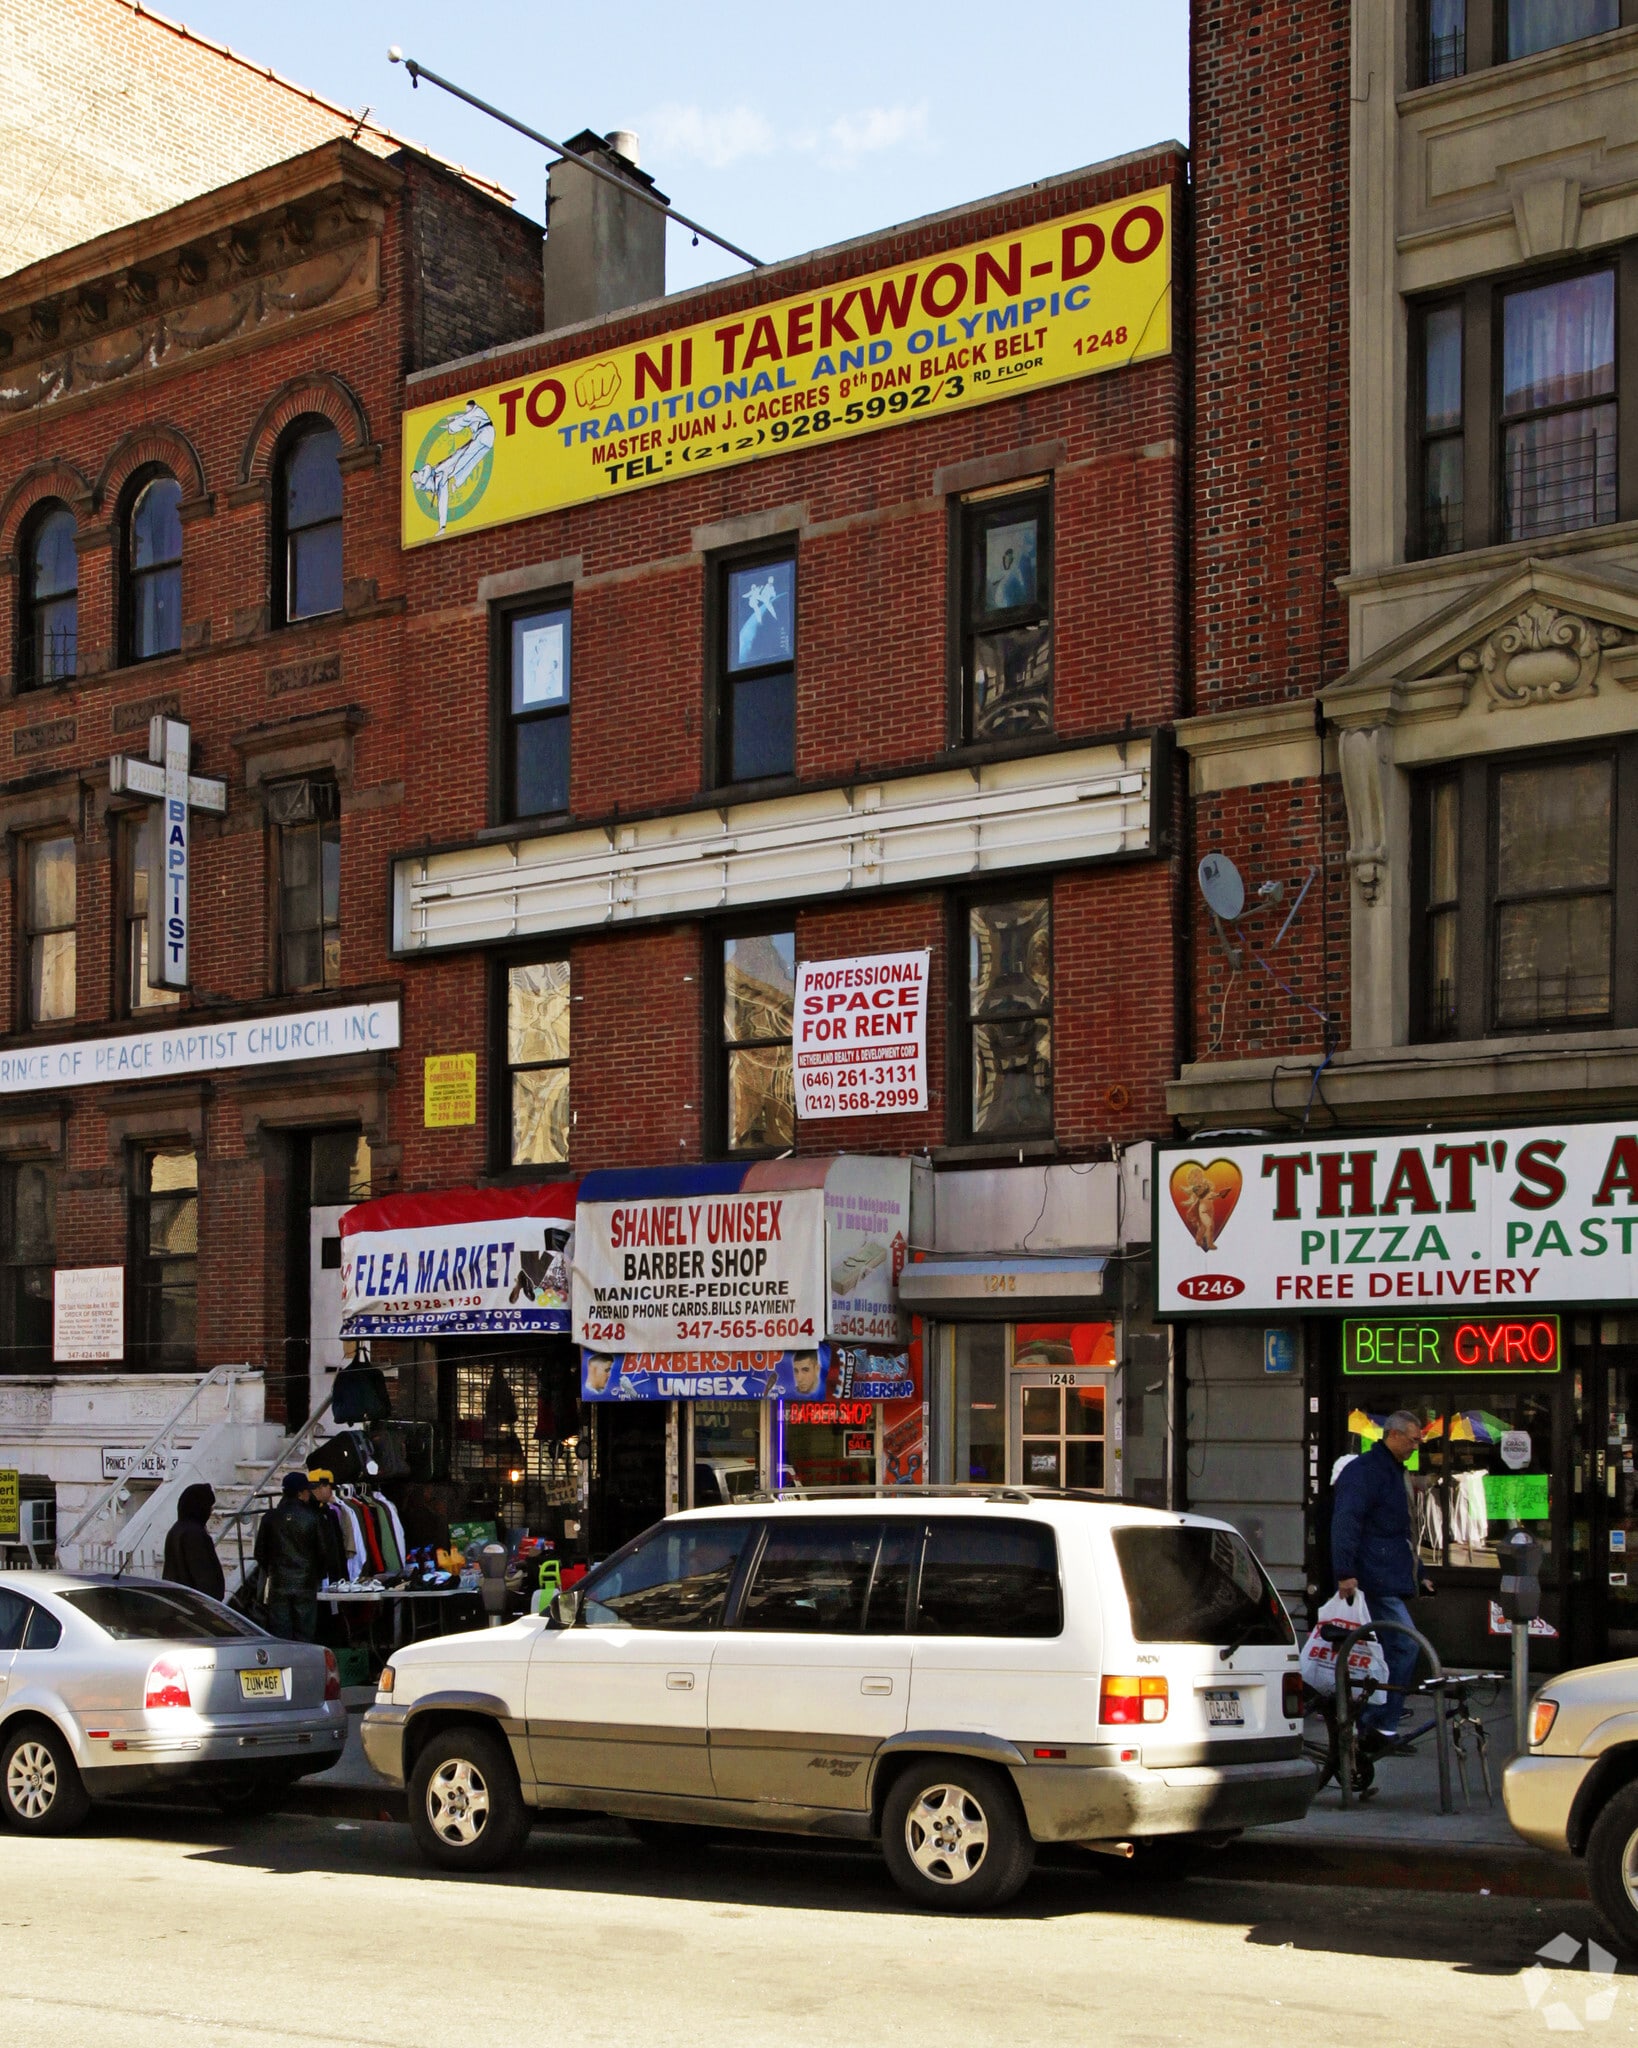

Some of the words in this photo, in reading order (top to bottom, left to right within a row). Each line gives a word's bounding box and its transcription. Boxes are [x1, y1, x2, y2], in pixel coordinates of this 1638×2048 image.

[499, 378, 566, 437] TO
[634, 338, 693, 400] NI
[714, 205, 1164, 374] TAEKWON-DO
[1073, 326, 1128, 356] 1248
[558, 366, 796, 447] TRADITIONAL
[811, 339, 892, 380] AND
[907, 284, 1091, 354] OLYMPIC
[592, 433, 662, 465] MASTER
[667, 416, 717, 445] JUAN
[722, 412, 737, 434] J.
[743, 385, 830, 426] CACERES
[840, 371, 867, 399] 8th
[871, 364, 911, 392] DAN
[920, 341, 987, 381] BLACK
[995, 327, 1048, 360] BELT
[605, 449, 673, 485] TEL:
[973, 369, 991, 383] RD
[998, 357, 1044, 377] FLOOR
[168, 800, 185, 962] BAPTIST
[804, 963, 922, 991] PROFESSIONAL
[803, 986, 920, 1016] SPACE
[802, 1017, 847, 1042] FOR
[855, 1011, 918, 1037] RENT
[59, 1051, 83, 1077] OF
[95, 1042, 152, 1072] PEACE
[163, 1031, 237, 1062] BAPTIST
[861, 1046, 900, 1061] DEVELOPMENT
[802, 1071, 834, 1091] (646)
[837, 1064, 916, 1088] 261-3131
[805, 1094, 836, 1112] (212)
[838, 1088, 919, 1111] 568-2999
[1260, 1138, 1568, 1222] THAT'S
[611, 1204, 702, 1248] SHANELY
[707, 1200, 783, 1245] UNISEX
[1300, 1224, 1451, 1266] PIZZA
[354, 1252, 408, 1298] FLEA
[414, 1242, 515, 1294] MARKET
[624, 1251, 705, 1281] BARBER
[711, 1248, 767, 1277] SHOP
[593, 1280, 789, 1302] MANICURE-PEDICURE
[984, 1275, 1016, 1293] 1248
[1186, 1280, 1234, 1296] 1246
[1276, 1274, 1354, 1300] FREE
[1369, 1267, 1541, 1298] DELIVERY
[371, 1312, 468, 1324] ELECTRONICS
[485, 1310, 522, 1319] TOYS
[384, 1301, 410, 1312] 212
[588, 1302, 629, 1320] PREPAID
[632, 1301, 669, 1318] PHONE
[744, 1298, 796, 1315] PAYMENT
[387, 1324, 440, 1334] CRAFTS
[455, 1322, 488, 1331] CD'S
[494, 1321, 504, 1330] &
[509, 1321, 560, 1331] DVD'S
[581, 1322, 626, 1341] 1248
[676, 1317, 815, 1339] 347-565-6604
[1356, 1327, 1441, 1364] BEER
[1454, 1321, 1556, 1365] GYRO
[620, 1351, 784, 1375] BARBERSHOP
[657, 1376, 749, 1397] UNISEX
[1049, 1374, 1075, 1386] 1248
[790, 1402, 837, 1424] BARBER
[839, 1402, 872, 1424] SHOP
[848, 1440, 871, 1449] SALE
[105, 1456, 126, 1471] PRINCE
[138, 1458, 154, 1470] EACE
[1309, 1646, 1371, 1668] BETER
